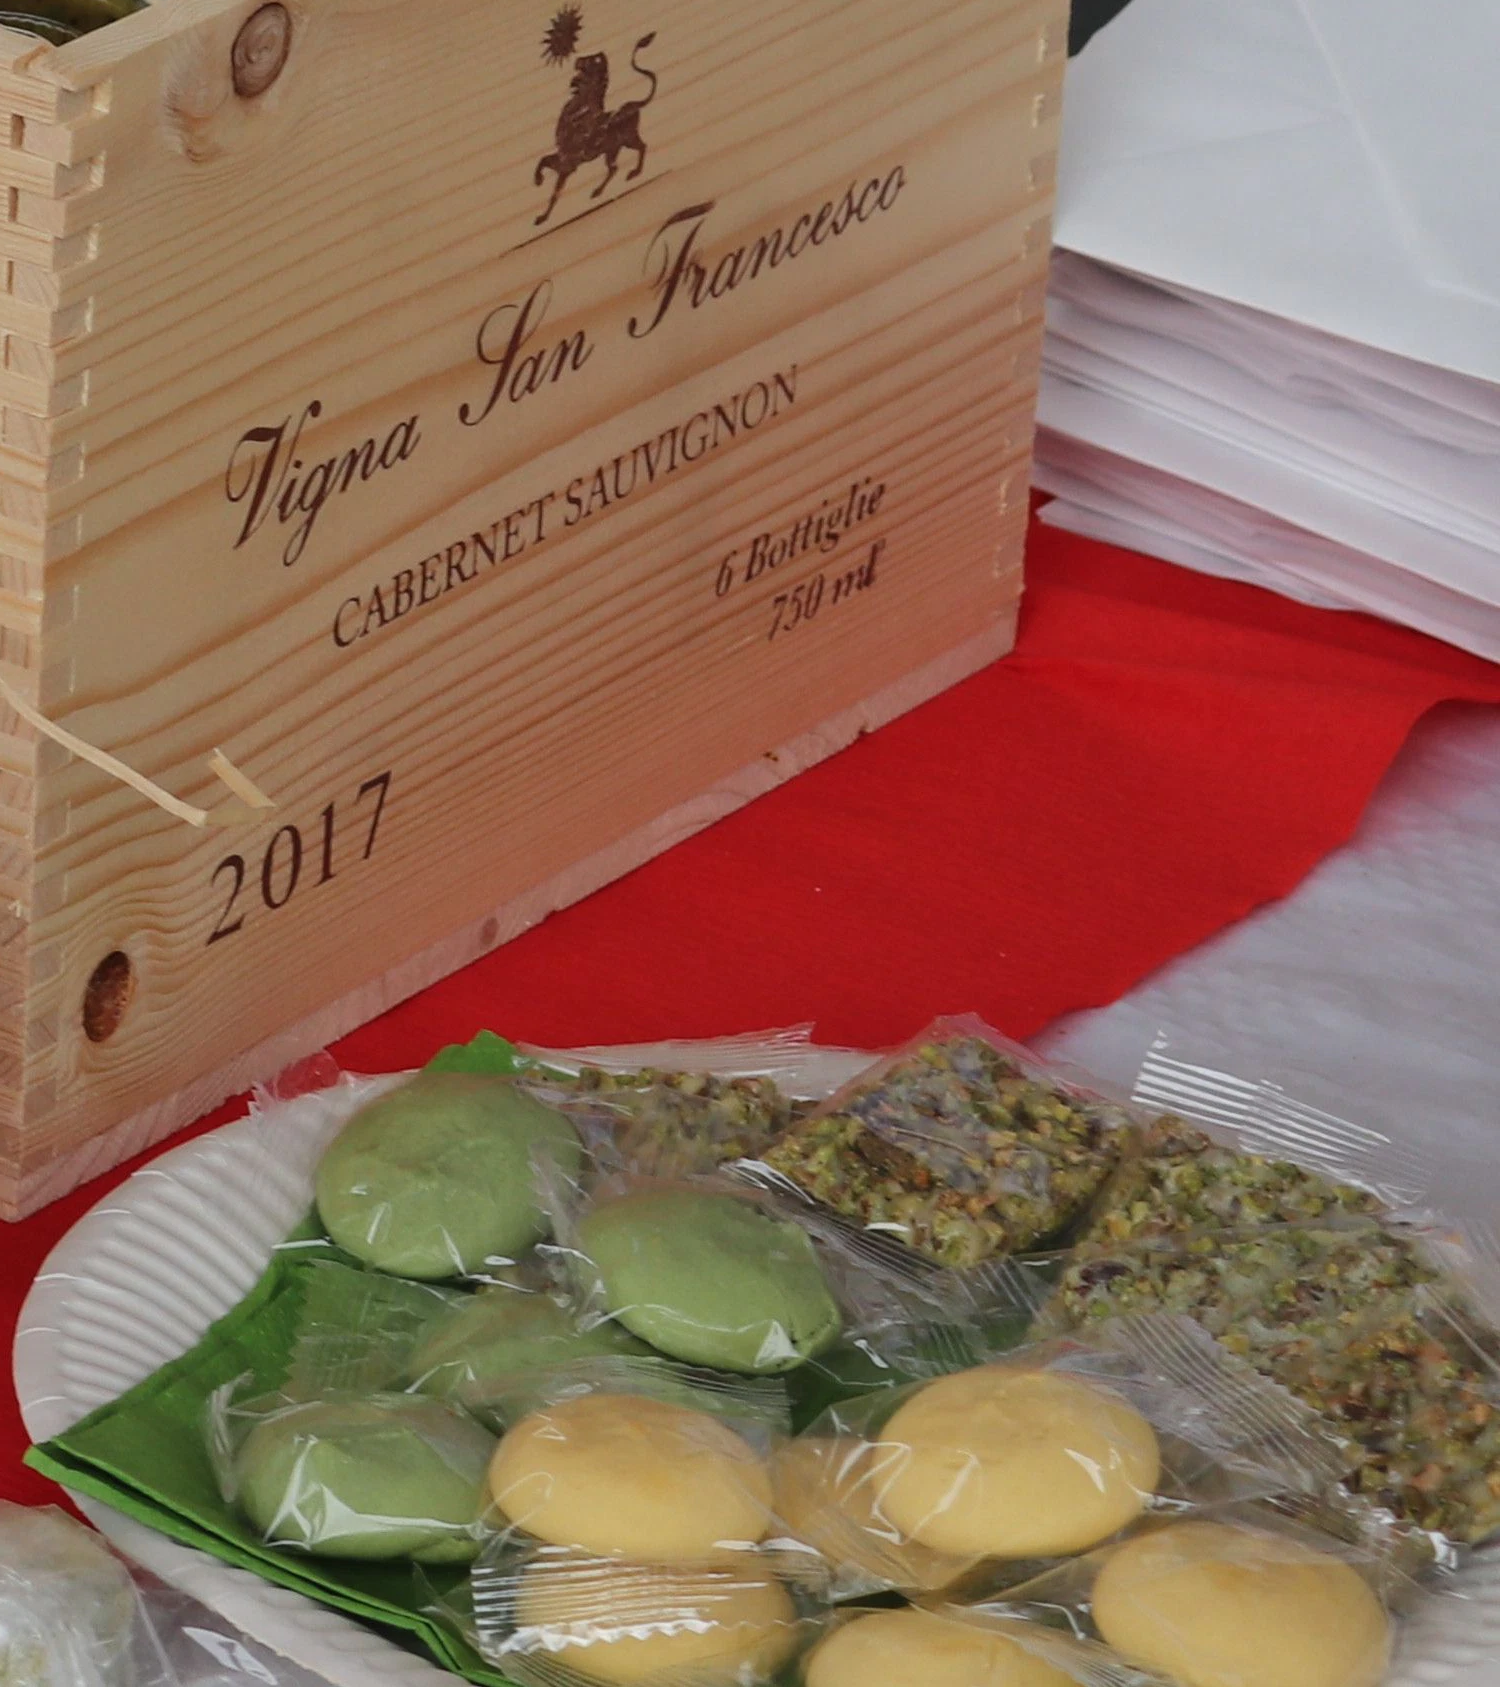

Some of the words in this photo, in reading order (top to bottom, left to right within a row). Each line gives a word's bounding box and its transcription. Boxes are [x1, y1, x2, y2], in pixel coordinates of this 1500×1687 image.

[222, 398, 423, 569] Vigna
[457, 277, 597, 429] San
[626, 163, 907, 341] Francesco
[329, 491, 558, 652] CABERNET
[560, 363, 802, 529] SAUVIGNON
[712, 550, 738, 599] 6
[741, 472, 886, 590] Bottiglie
[765, 577, 824, 644] 750
[204, 767, 394, 951] 2017
